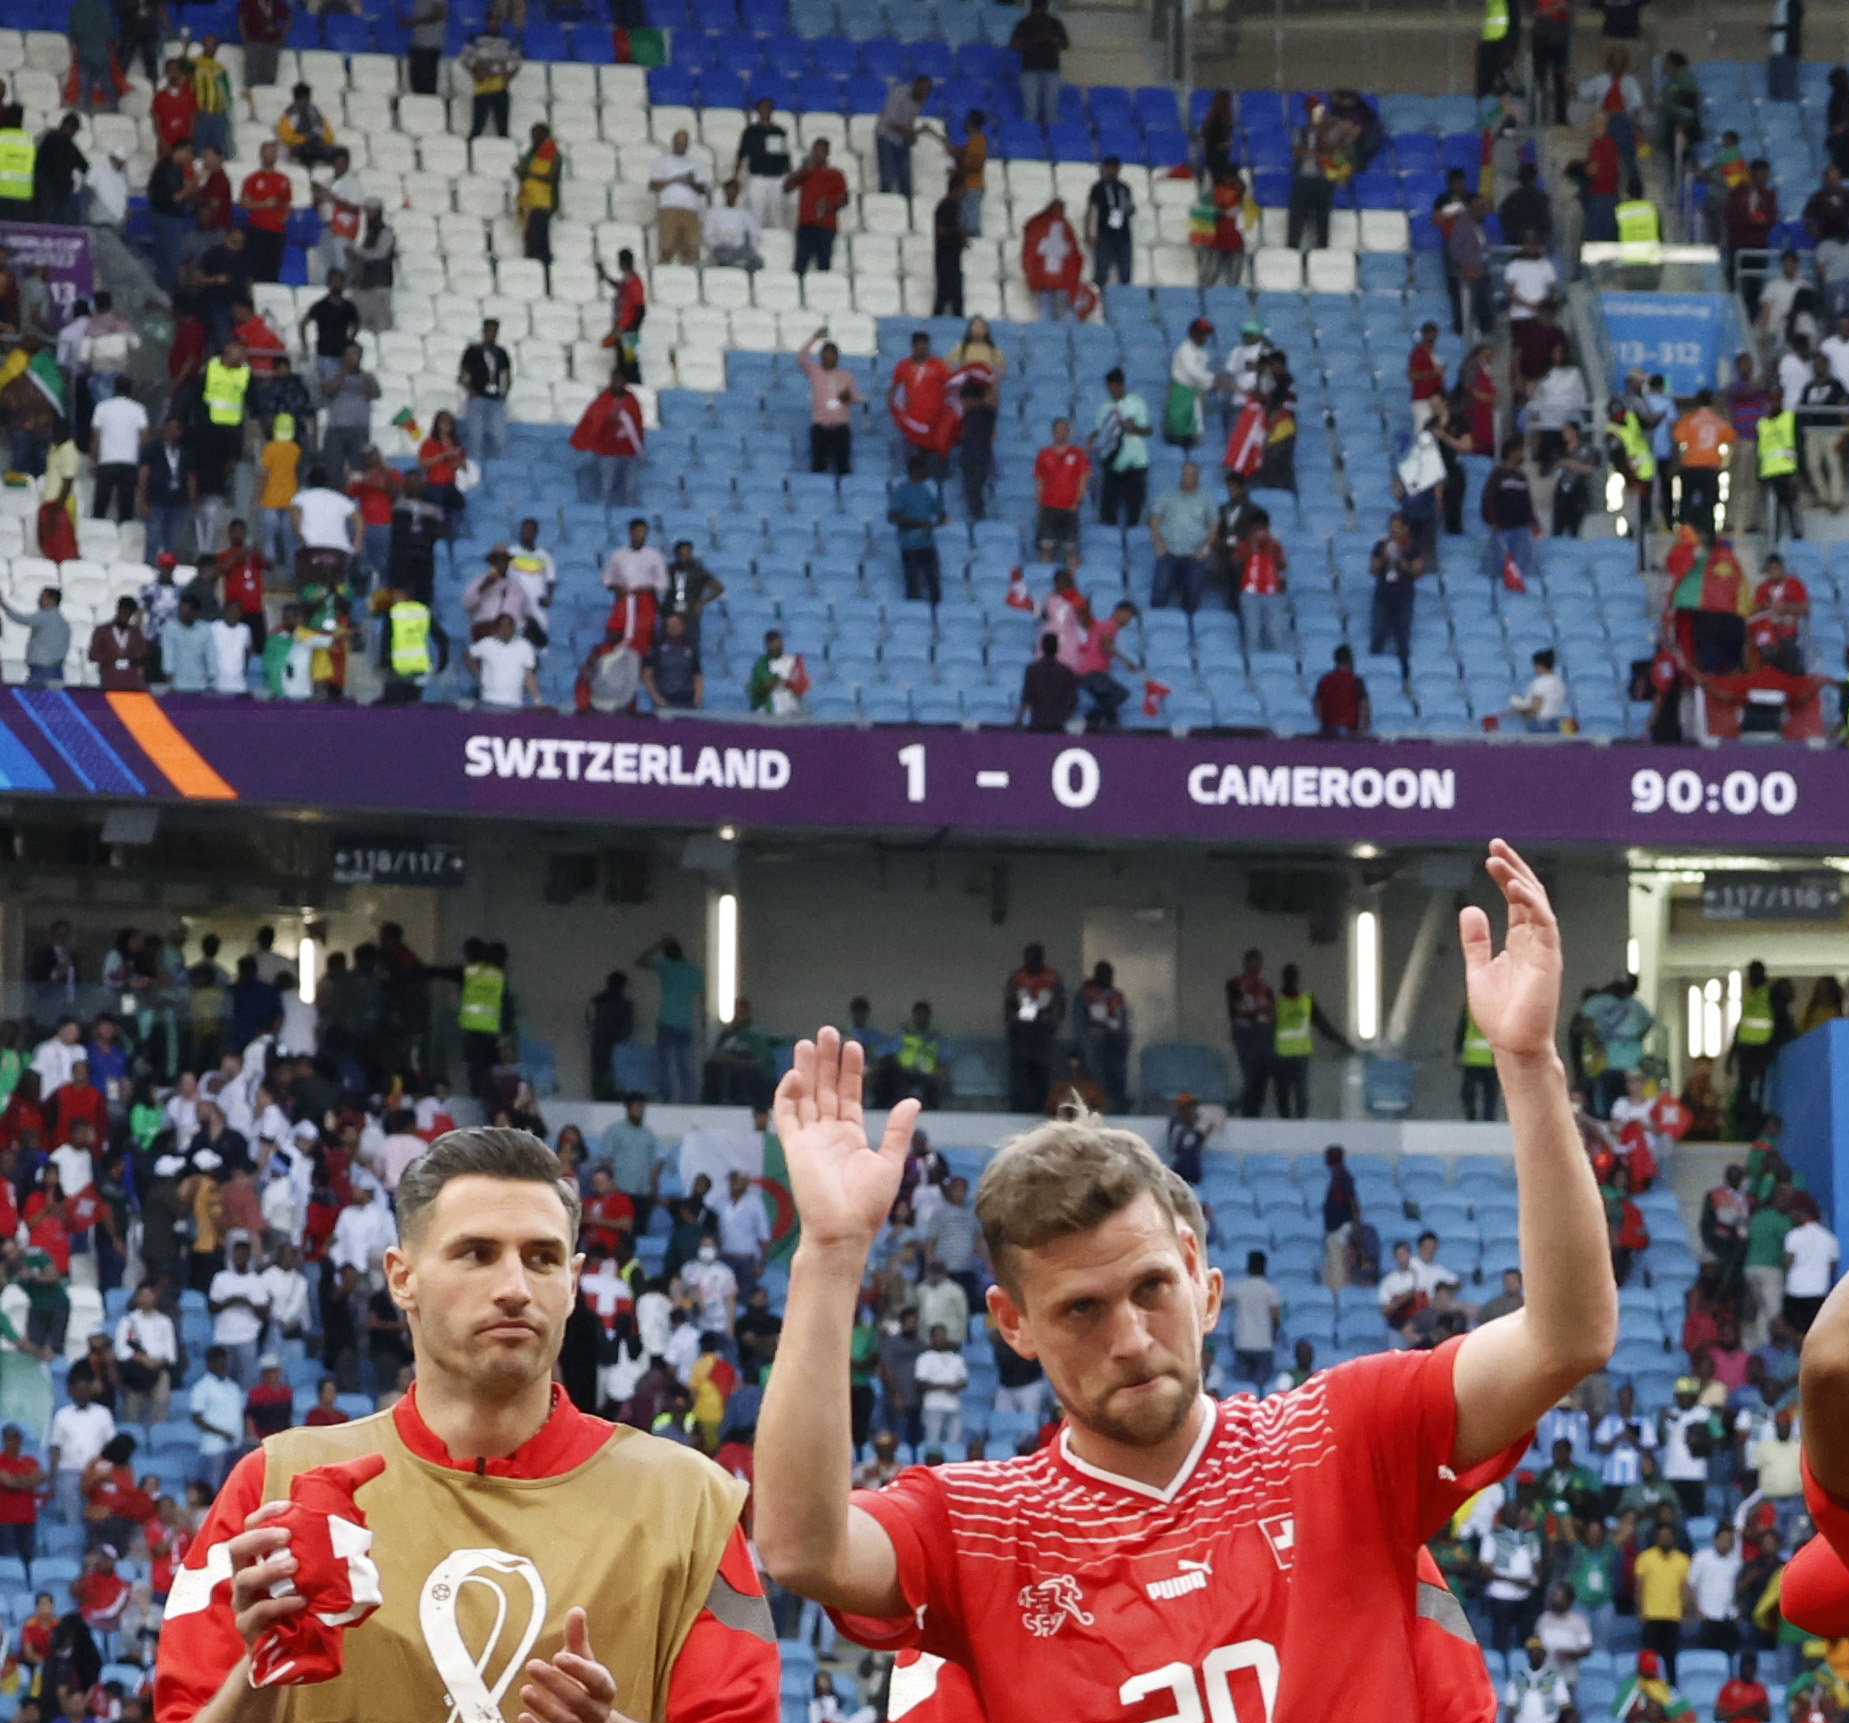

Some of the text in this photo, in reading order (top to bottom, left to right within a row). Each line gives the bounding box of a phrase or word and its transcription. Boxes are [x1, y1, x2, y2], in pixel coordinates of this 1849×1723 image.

[464, 735, 791, 791] SWITZERLAND
[897, 742, 927, 803] 1
[1051, 746, 1101, 810] 0
[1188, 762, 1456, 811] CAMEROON
[1630, 768, 1798, 817] 90:00
[1145, 1569, 1208, 1601] PUMA
